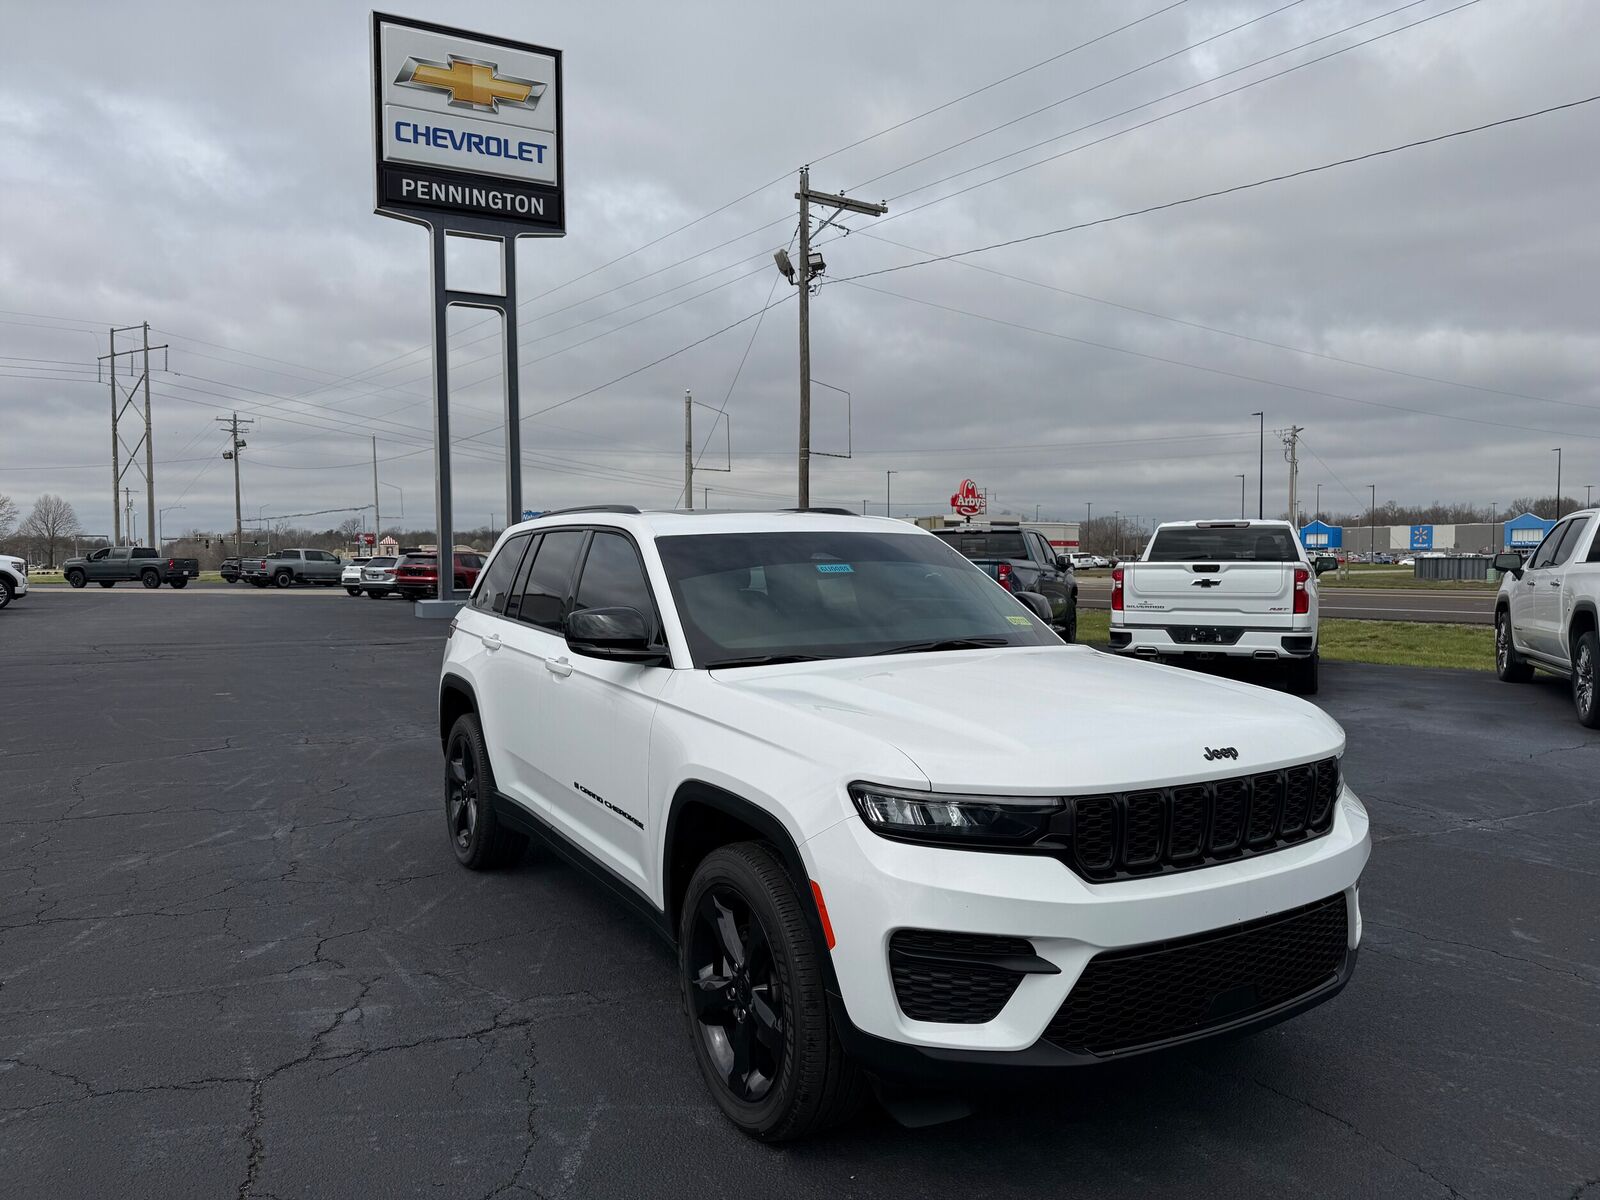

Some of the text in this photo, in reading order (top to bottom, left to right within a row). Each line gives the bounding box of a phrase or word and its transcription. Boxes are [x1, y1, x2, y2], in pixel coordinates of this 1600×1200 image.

[395, 121, 548, 163] CHEVROLET
[402, 178, 545, 215] PENNINGTON
[957, 494, 986, 508] Arby's
[1203, 746, 1239, 761] Jeep
[580, 785, 645, 831] GRAND CHEROKEE
